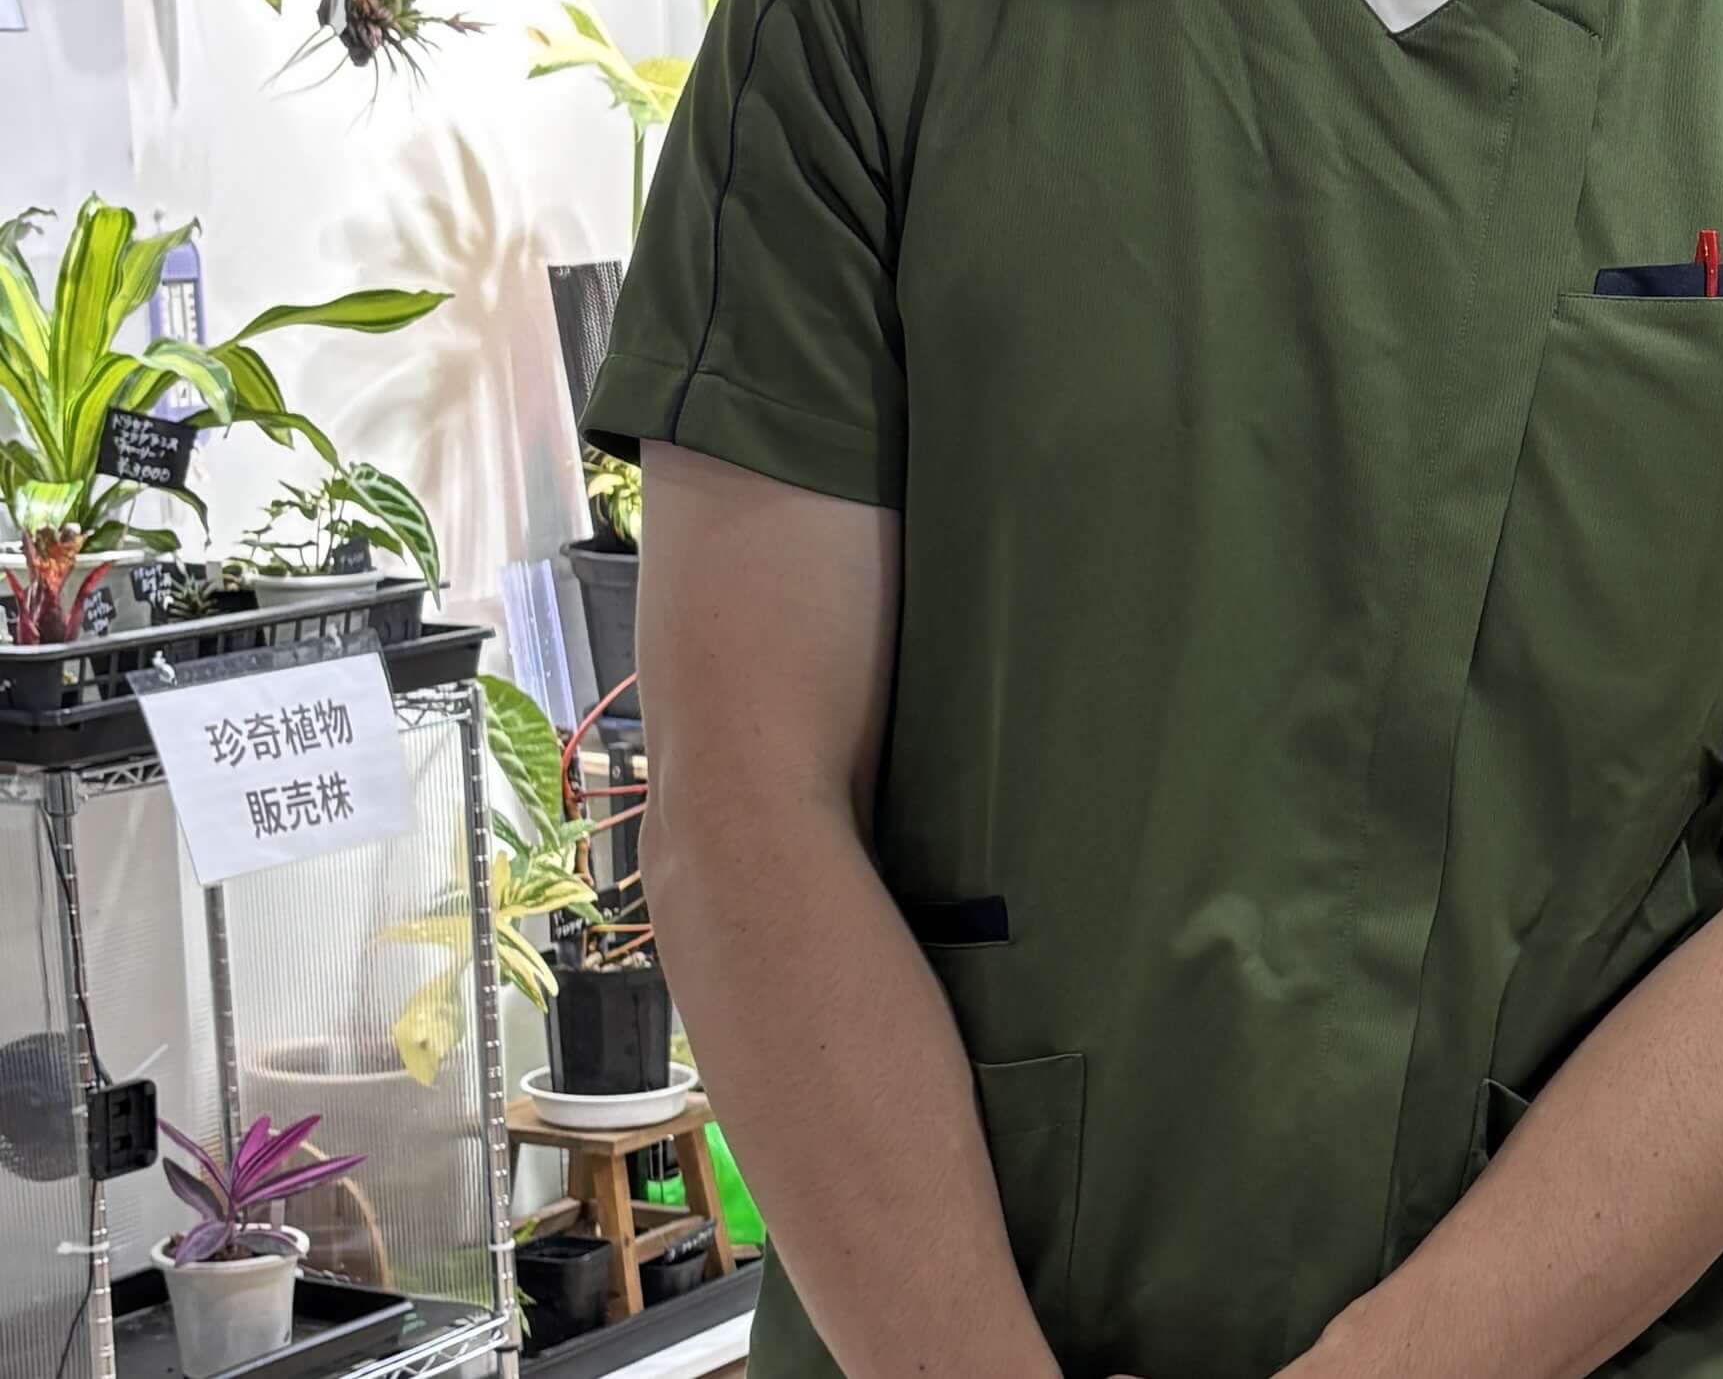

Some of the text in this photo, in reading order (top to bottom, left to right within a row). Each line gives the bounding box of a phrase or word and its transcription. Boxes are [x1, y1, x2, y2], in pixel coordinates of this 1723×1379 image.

[204, 698, 354, 768] 珍奇植物
[245, 770, 355, 840] 販売株
